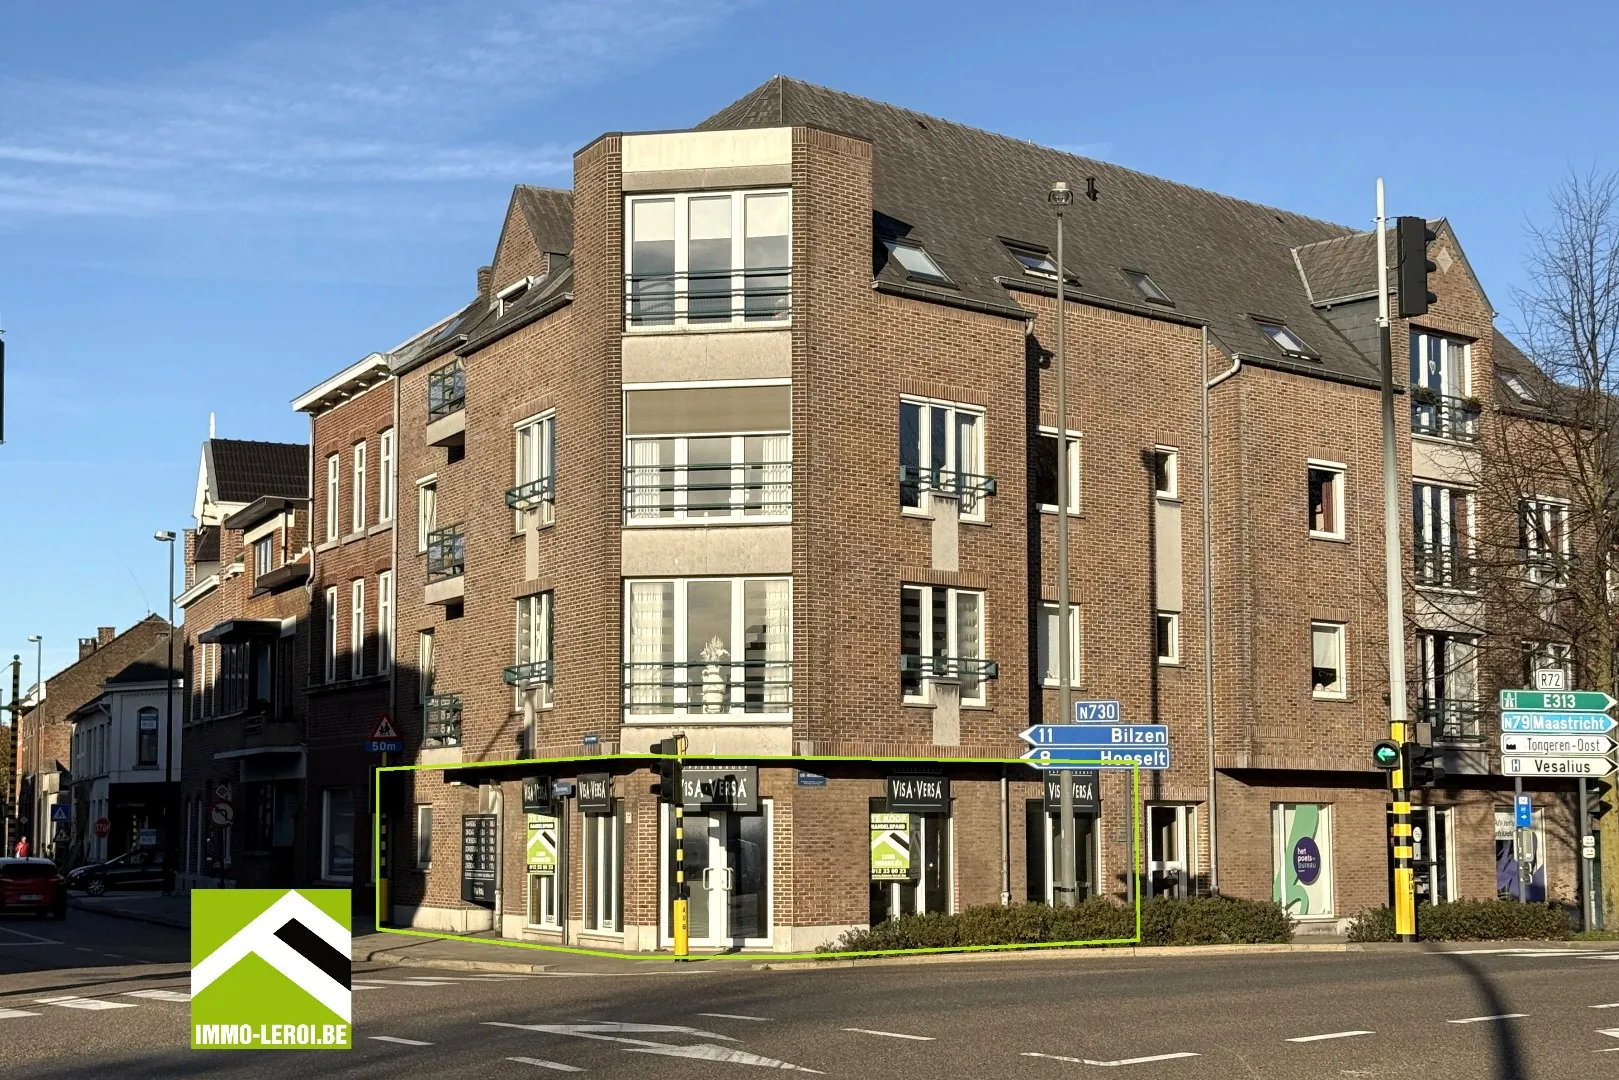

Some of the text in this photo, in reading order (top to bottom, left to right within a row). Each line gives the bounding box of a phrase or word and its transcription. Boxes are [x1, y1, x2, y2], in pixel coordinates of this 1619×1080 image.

[1541, 674, 1561, 687] R72
[1543, 694, 1576, 708] E313
[1079, 704, 1115, 719] N730
[1504, 715, 1604, 730] N79 Maastricht
[1039, 728, 1165, 742] 11 Bilzen
[372, 741, 396, 751] 50m
[1527, 738, 1600, 755] Tongeren-Oost
[1040, 751, 1166, 765] 8 Hoeselt
[1534, 759, 1591, 773] Vesalius
